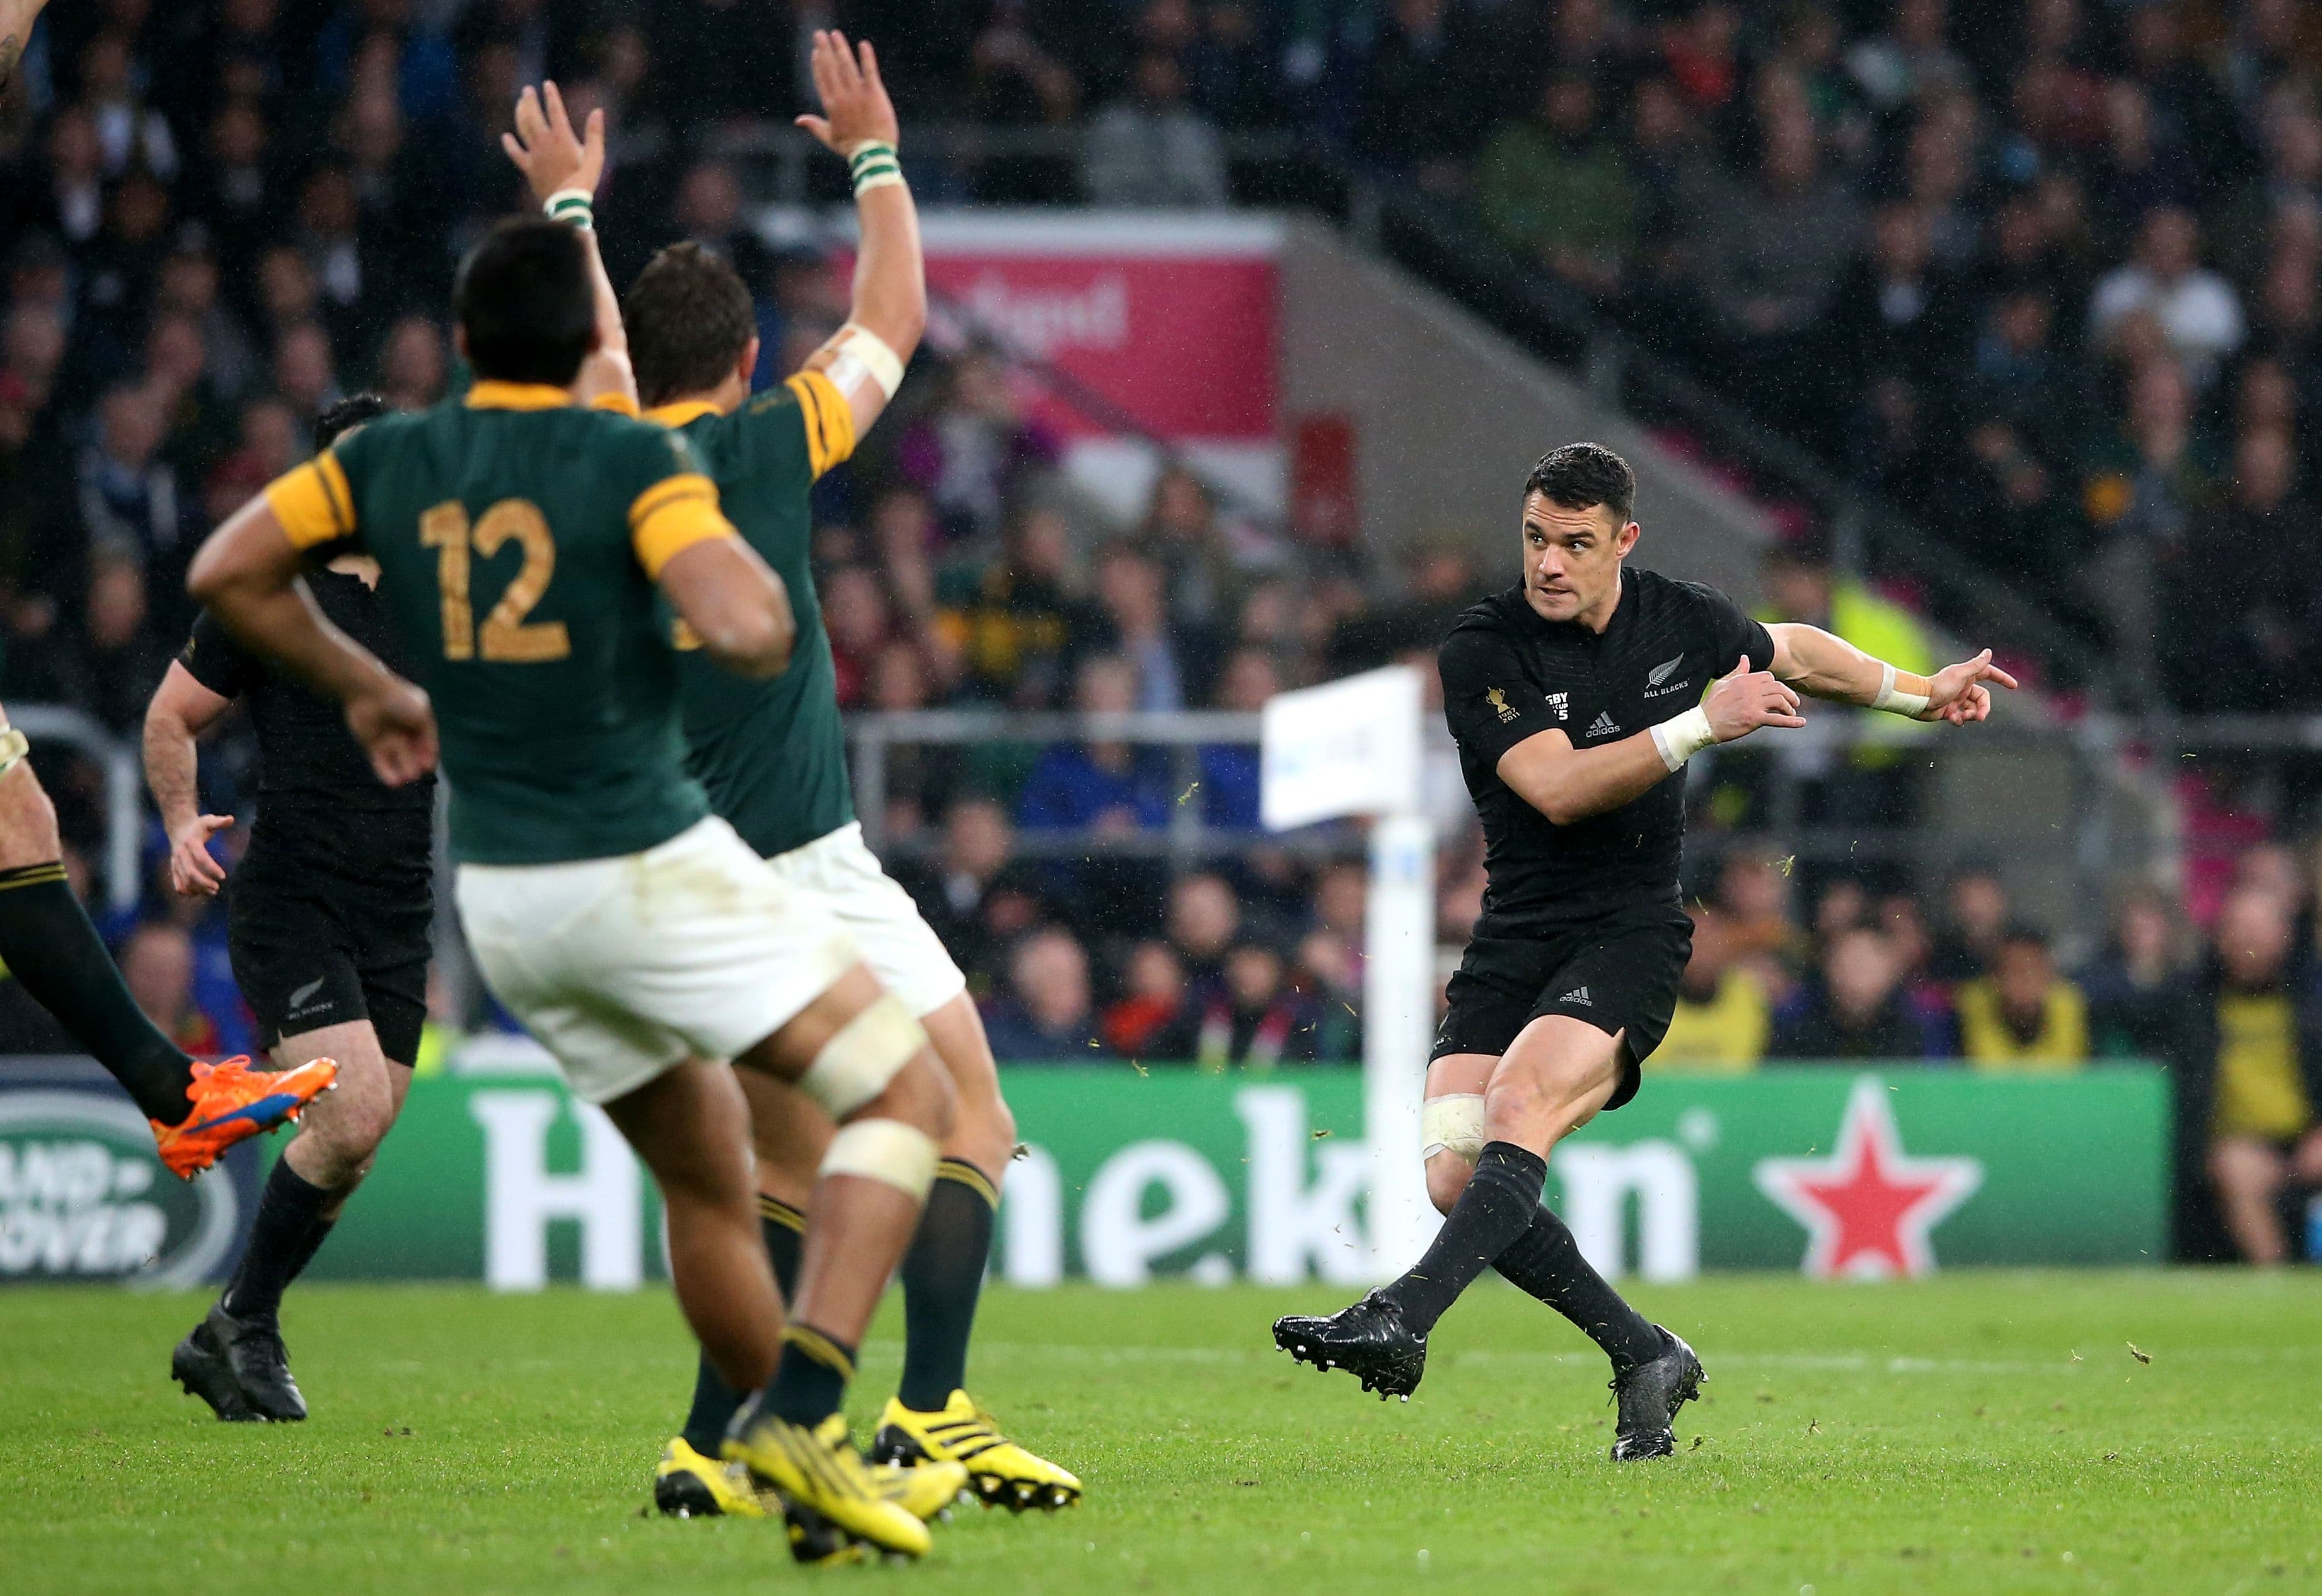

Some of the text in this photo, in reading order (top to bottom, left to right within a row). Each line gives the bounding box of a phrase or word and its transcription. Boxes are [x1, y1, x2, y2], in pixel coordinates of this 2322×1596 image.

[419, 497, 572, 664] 12
[1644, 681, 1689, 698] ALL BLACKS
[1498, 707, 1516, 719] 1987
[1502, 712, 1520, 724] 2011
[1586, 725, 1620, 737] adidas
[1559, 996, 1592, 1007] adidas
